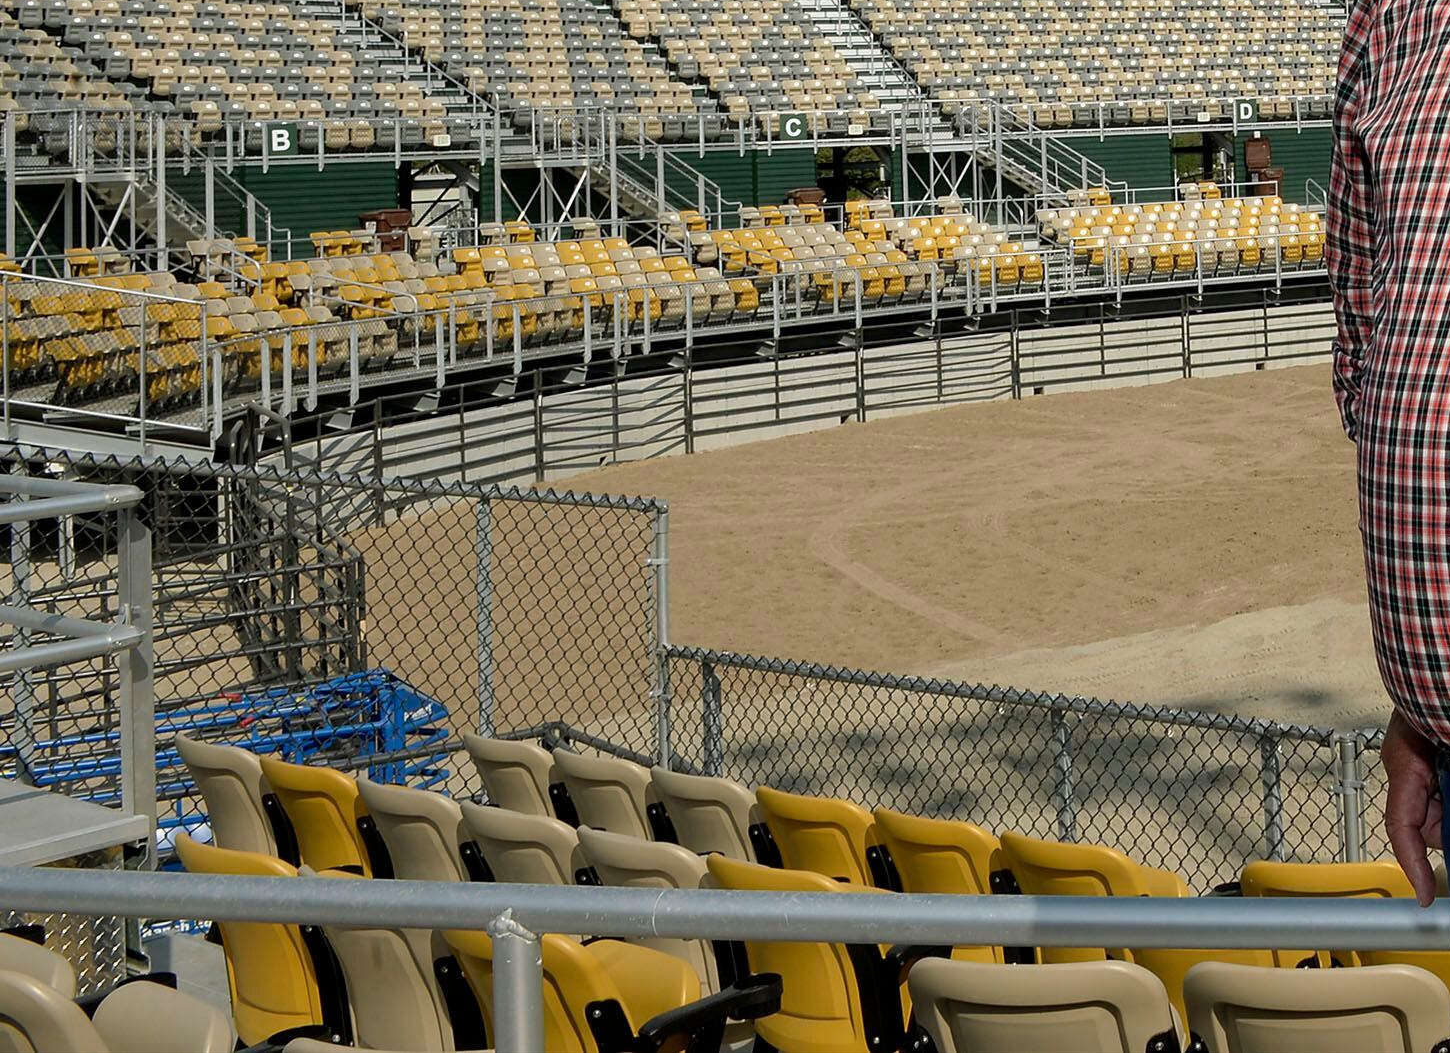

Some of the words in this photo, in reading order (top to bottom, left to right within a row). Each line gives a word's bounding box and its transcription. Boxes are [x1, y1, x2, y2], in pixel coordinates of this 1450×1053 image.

[1240, 103, 1253, 120] D
[785, 118, 802, 137] C
[271, 129, 291, 152] B
